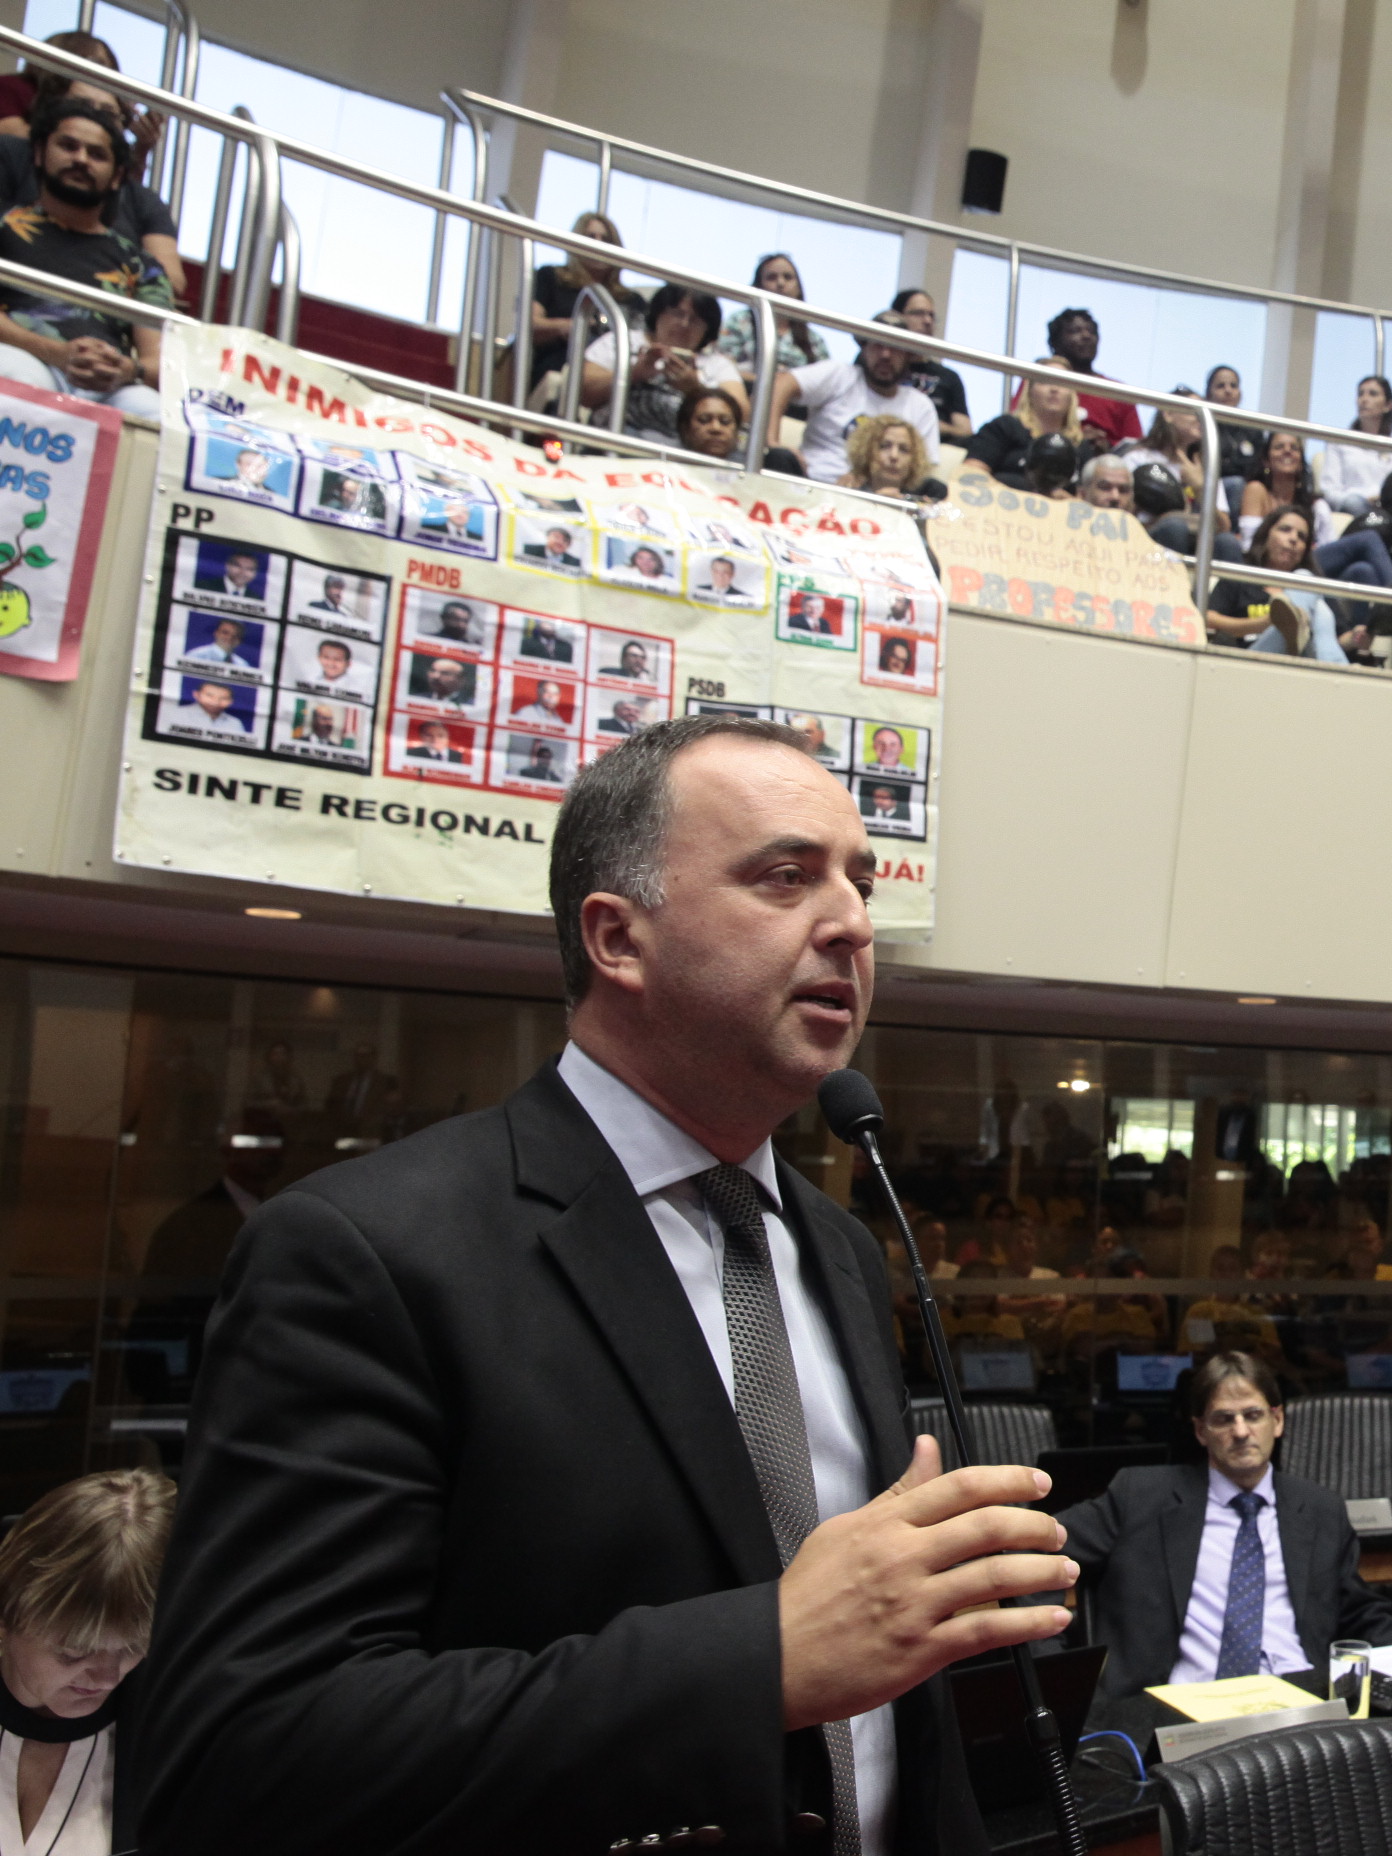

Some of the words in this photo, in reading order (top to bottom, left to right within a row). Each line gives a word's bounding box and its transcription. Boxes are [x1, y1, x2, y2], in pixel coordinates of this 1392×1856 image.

[220, 348, 494, 463] INIMIGOS
[513, 456, 587, 483] DA
[0, 463, 51, 501] AS
[171, 502, 216, 529] PP
[1067, 501, 1129, 543] PAI
[962, 516, 1055, 546] ESTOU
[1064, 537, 1113, 563] AQUI
[405, 558, 462, 590] PMDB
[934, 535, 1007, 564] PEDIR
[1015, 546, 1122, 585] RESPEITO
[687, 676, 726, 698] PSDB
[153, 767, 304, 812] SINTE
[319, 792, 546, 845] REGIONAL
[873, 857, 926, 884] JÁ!
